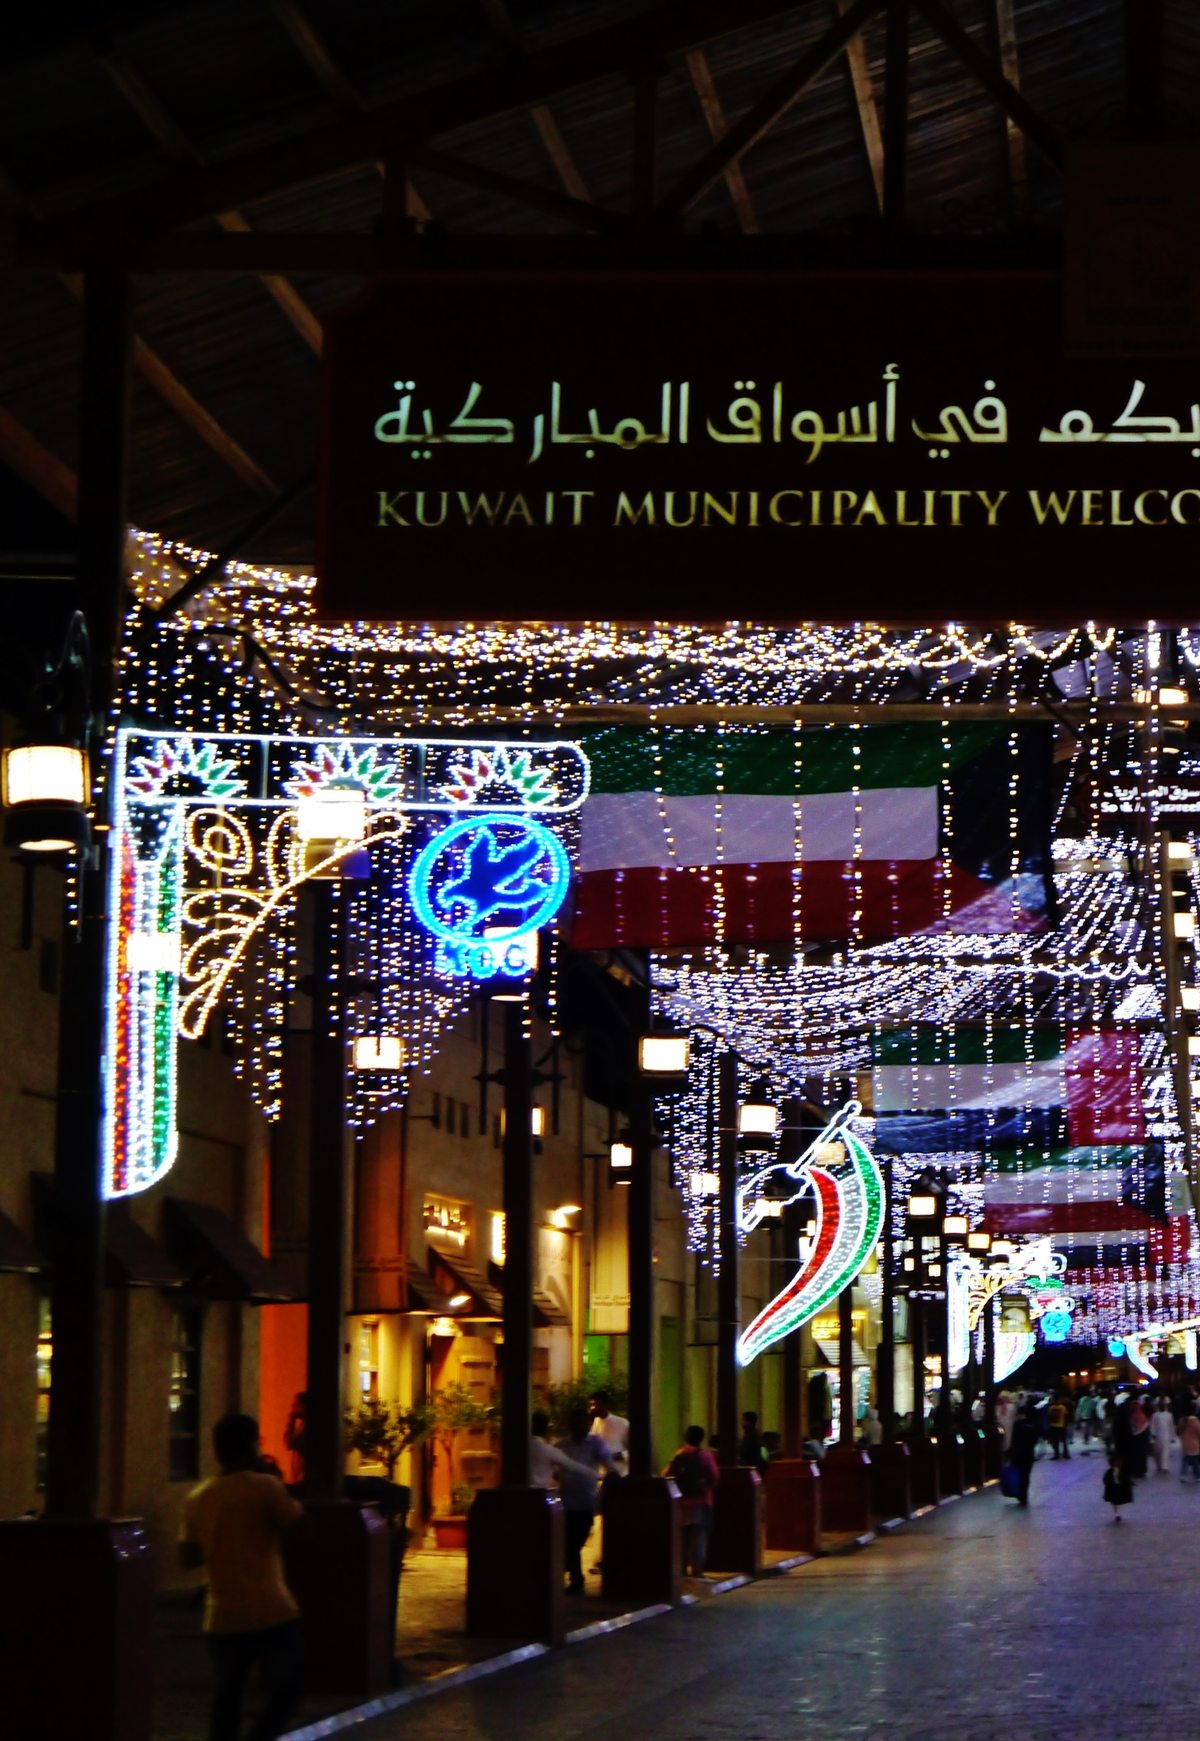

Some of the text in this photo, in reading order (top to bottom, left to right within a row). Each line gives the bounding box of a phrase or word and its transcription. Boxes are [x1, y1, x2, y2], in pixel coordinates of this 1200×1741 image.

[373, 379, 691, 464] المباركية
[705, 361, 901, 464] أسواق
[910, 378, 1009, 460] في
[376, 490, 595, 527] KUWAIT
[613, 489, 1009, 527] MUNICIPALITY
